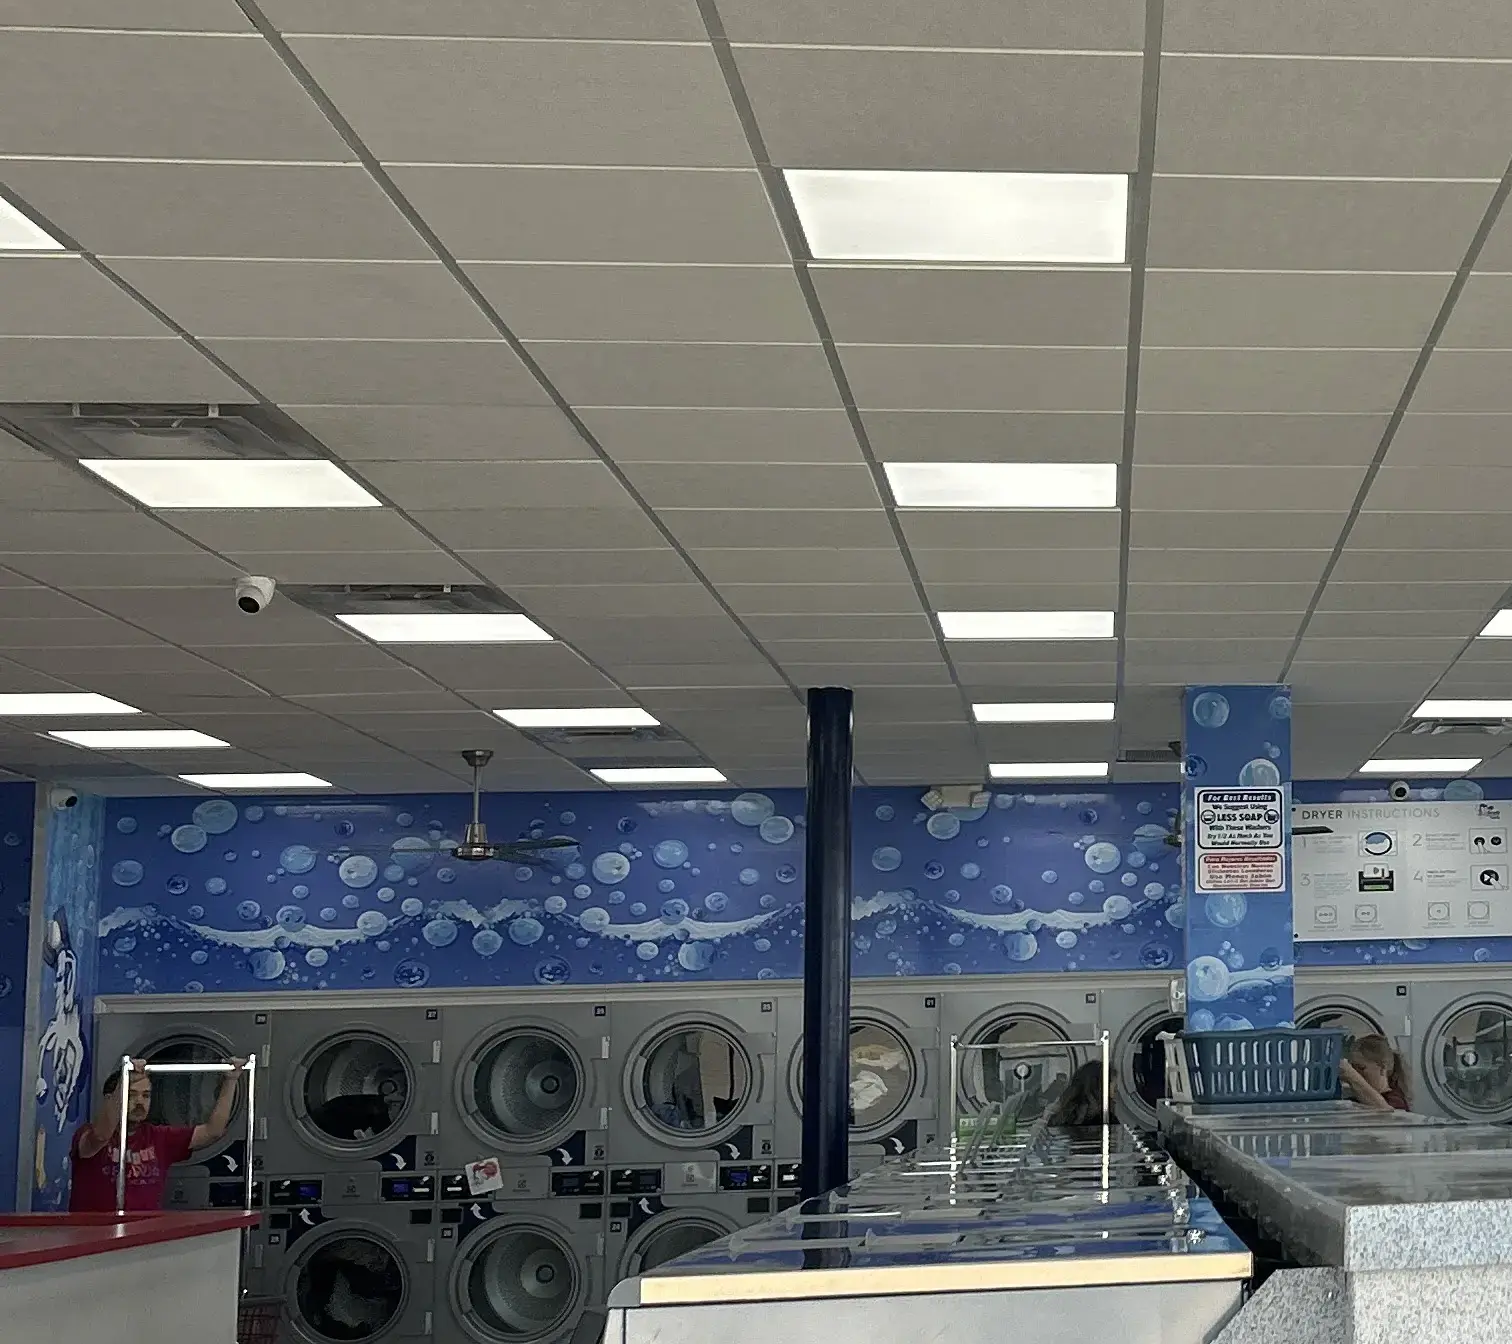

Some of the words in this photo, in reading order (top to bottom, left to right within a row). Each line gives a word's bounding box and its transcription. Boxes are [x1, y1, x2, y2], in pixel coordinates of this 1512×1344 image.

[1207, 794, 1222, 803] For
[1223, 794, 1241, 802] Best
[1242, 793, 1273, 802] Results
[1250, 803, 1269, 811] Using
[1301, 809, 1343, 820] DRYER
[1347, 807, 1440, 819] INSTRUCTIONS
[1217, 813, 1238, 822] LESS
[1239, 812, 1264, 822] SOAP
[1412, 833, 1423, 847] 2
[1300, 872, 1311, 886] 3
[1413, 870, 1424, 883] 4
